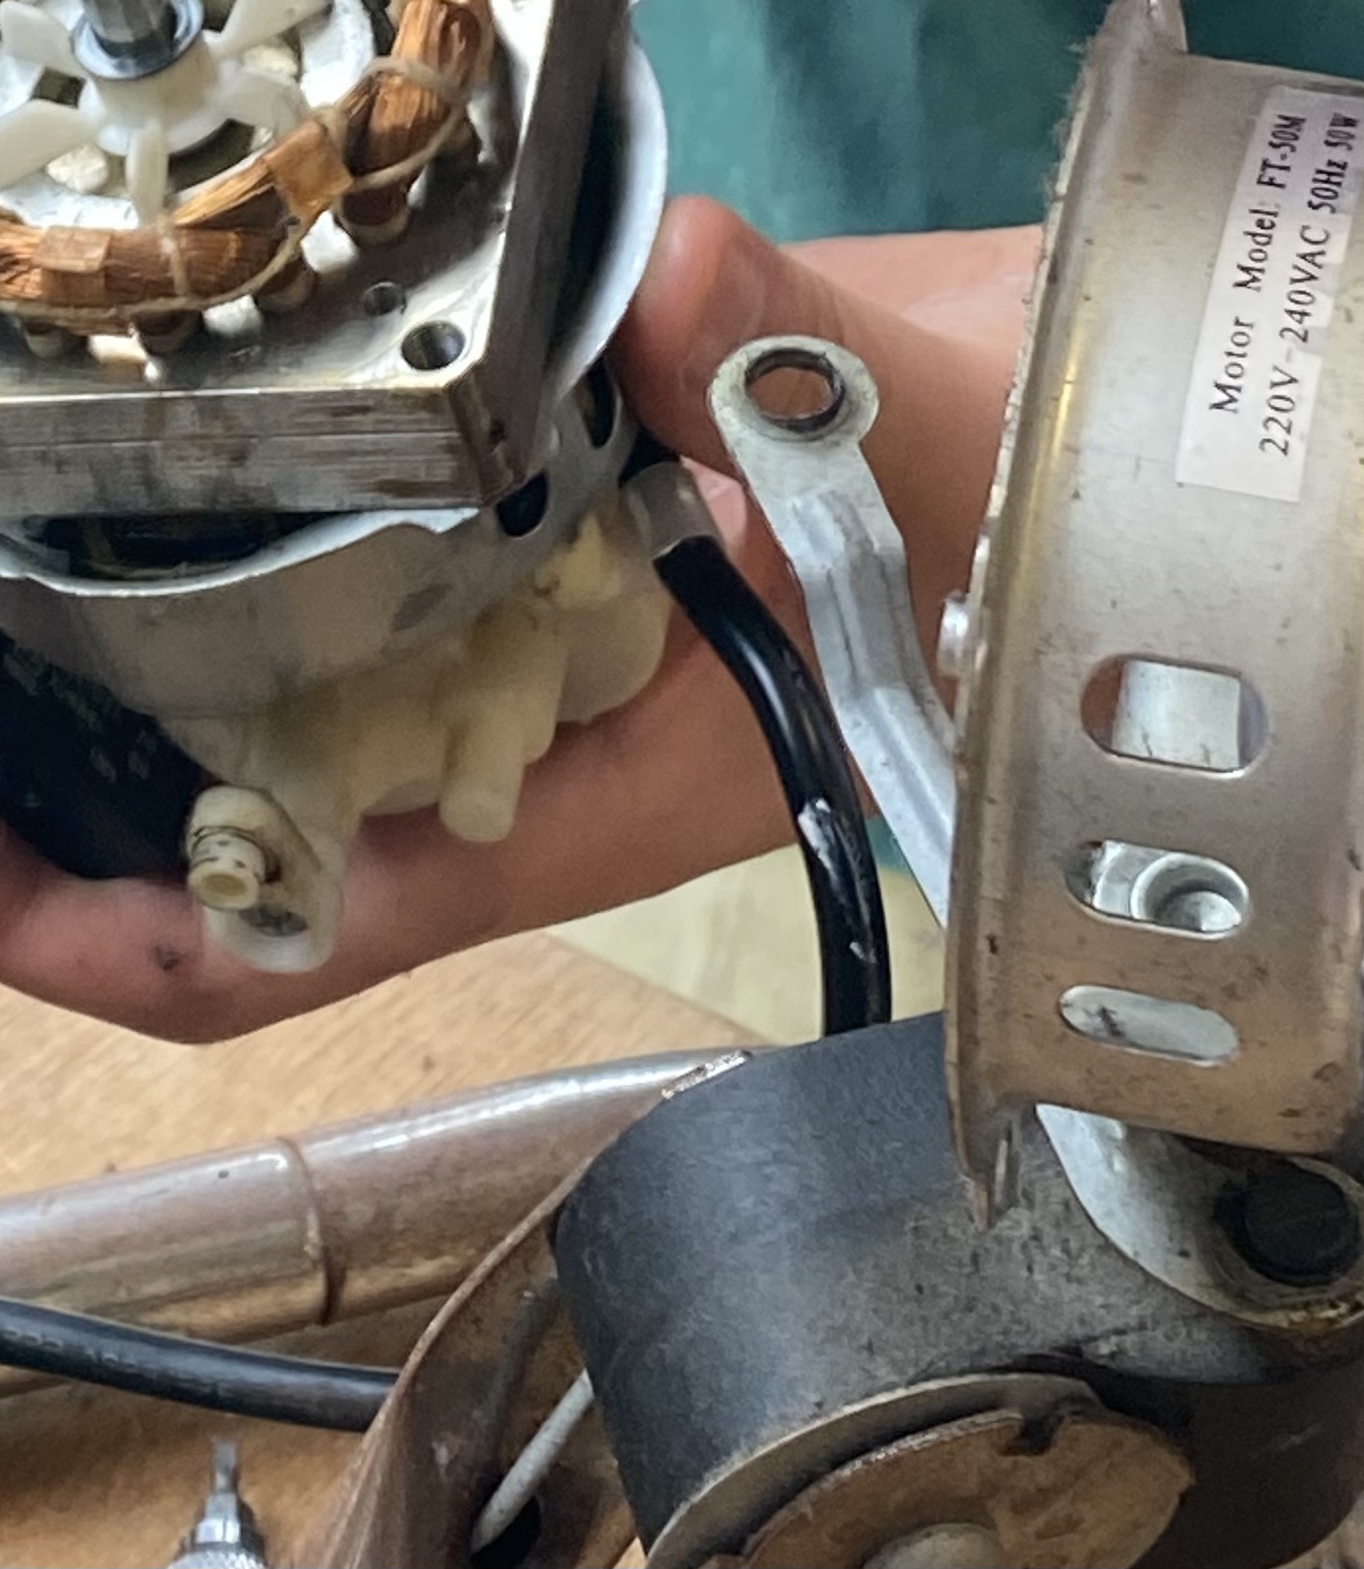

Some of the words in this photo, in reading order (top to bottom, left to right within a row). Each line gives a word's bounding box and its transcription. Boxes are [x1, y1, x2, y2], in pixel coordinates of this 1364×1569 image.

[1323, 112, 1360, 152] 50W
[1306, 158, 1349, 214] 50Hz
[1208, 315, 1255, 414] Motor
[1256, 113, 1307, 190] FT-50M
